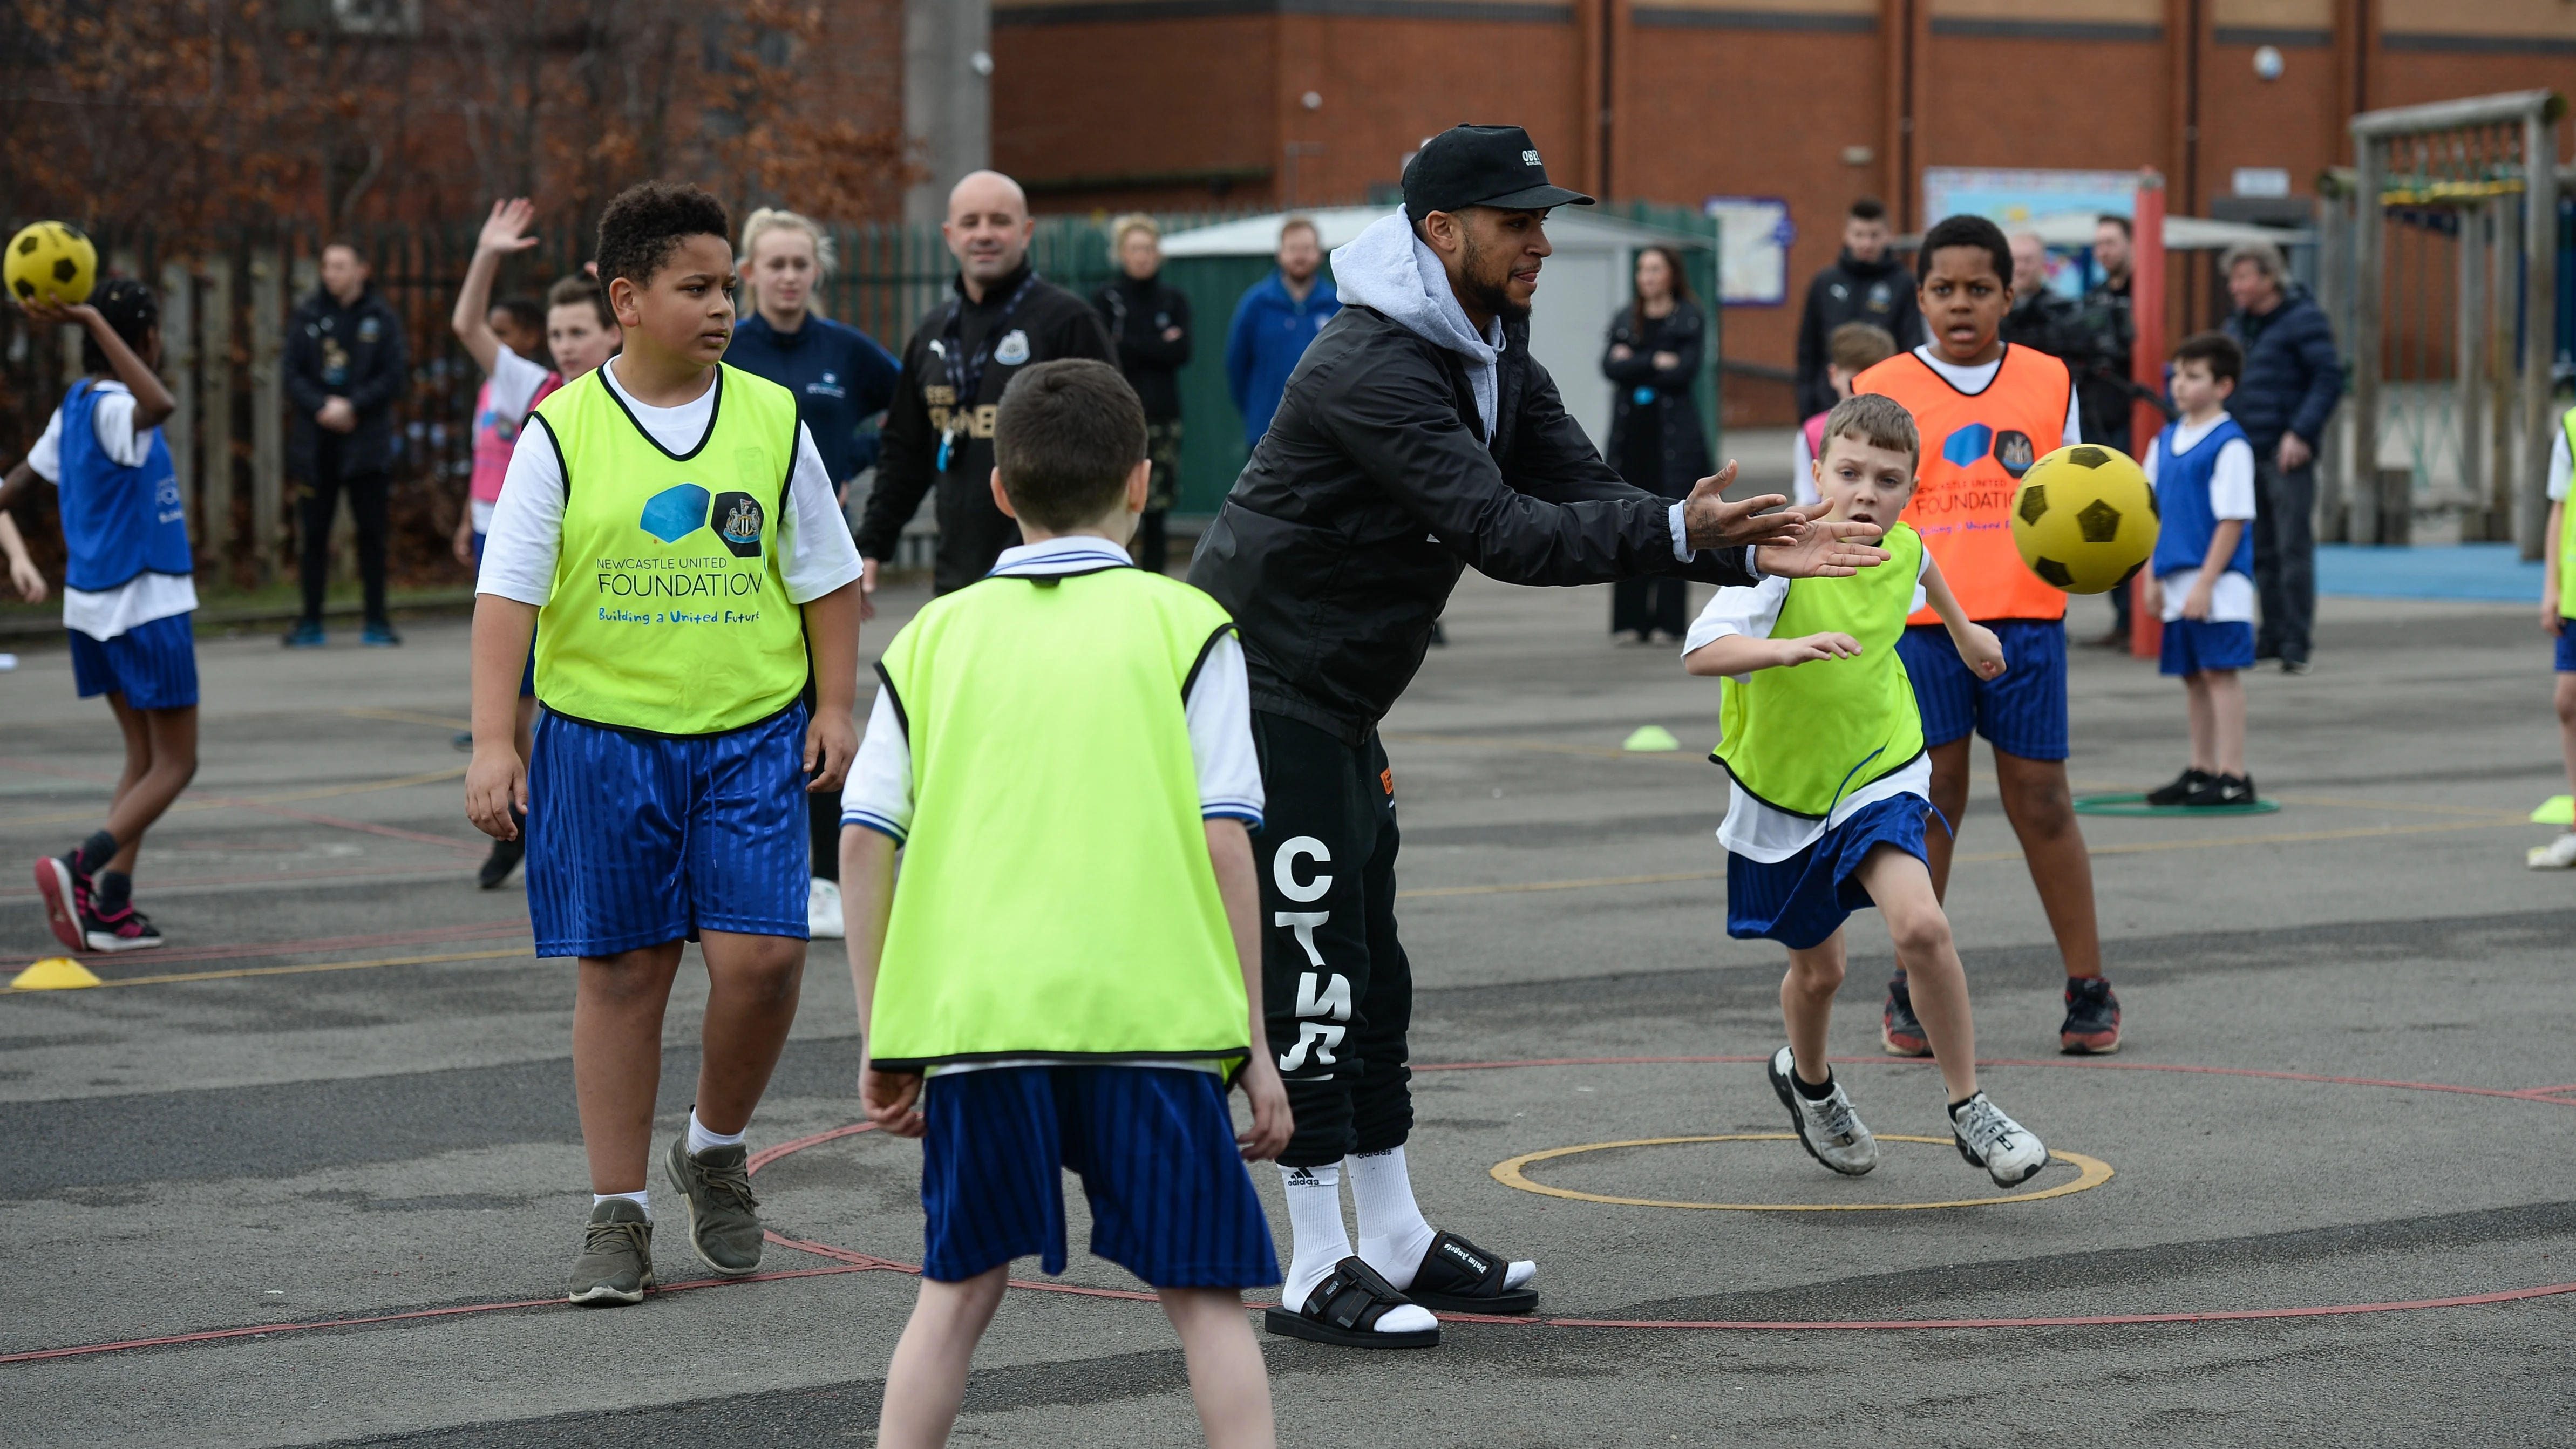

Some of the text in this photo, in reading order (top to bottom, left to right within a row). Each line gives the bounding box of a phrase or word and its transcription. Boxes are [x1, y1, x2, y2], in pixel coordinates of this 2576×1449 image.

[1916, 491, 2016, 516] FOUNDATI
[597, 557, 727, 570] NEWCASTLE UNITED
[597, 573, 762, 597] FOUNDATION
[599, 608, 649, 625] Building
[656, 614, 664, 623] a
[670, 610, 718, 624] United
[1274, 836, 1352, 1080] СТИЛ
[1288, 1178, 1320, 1186] adidas
